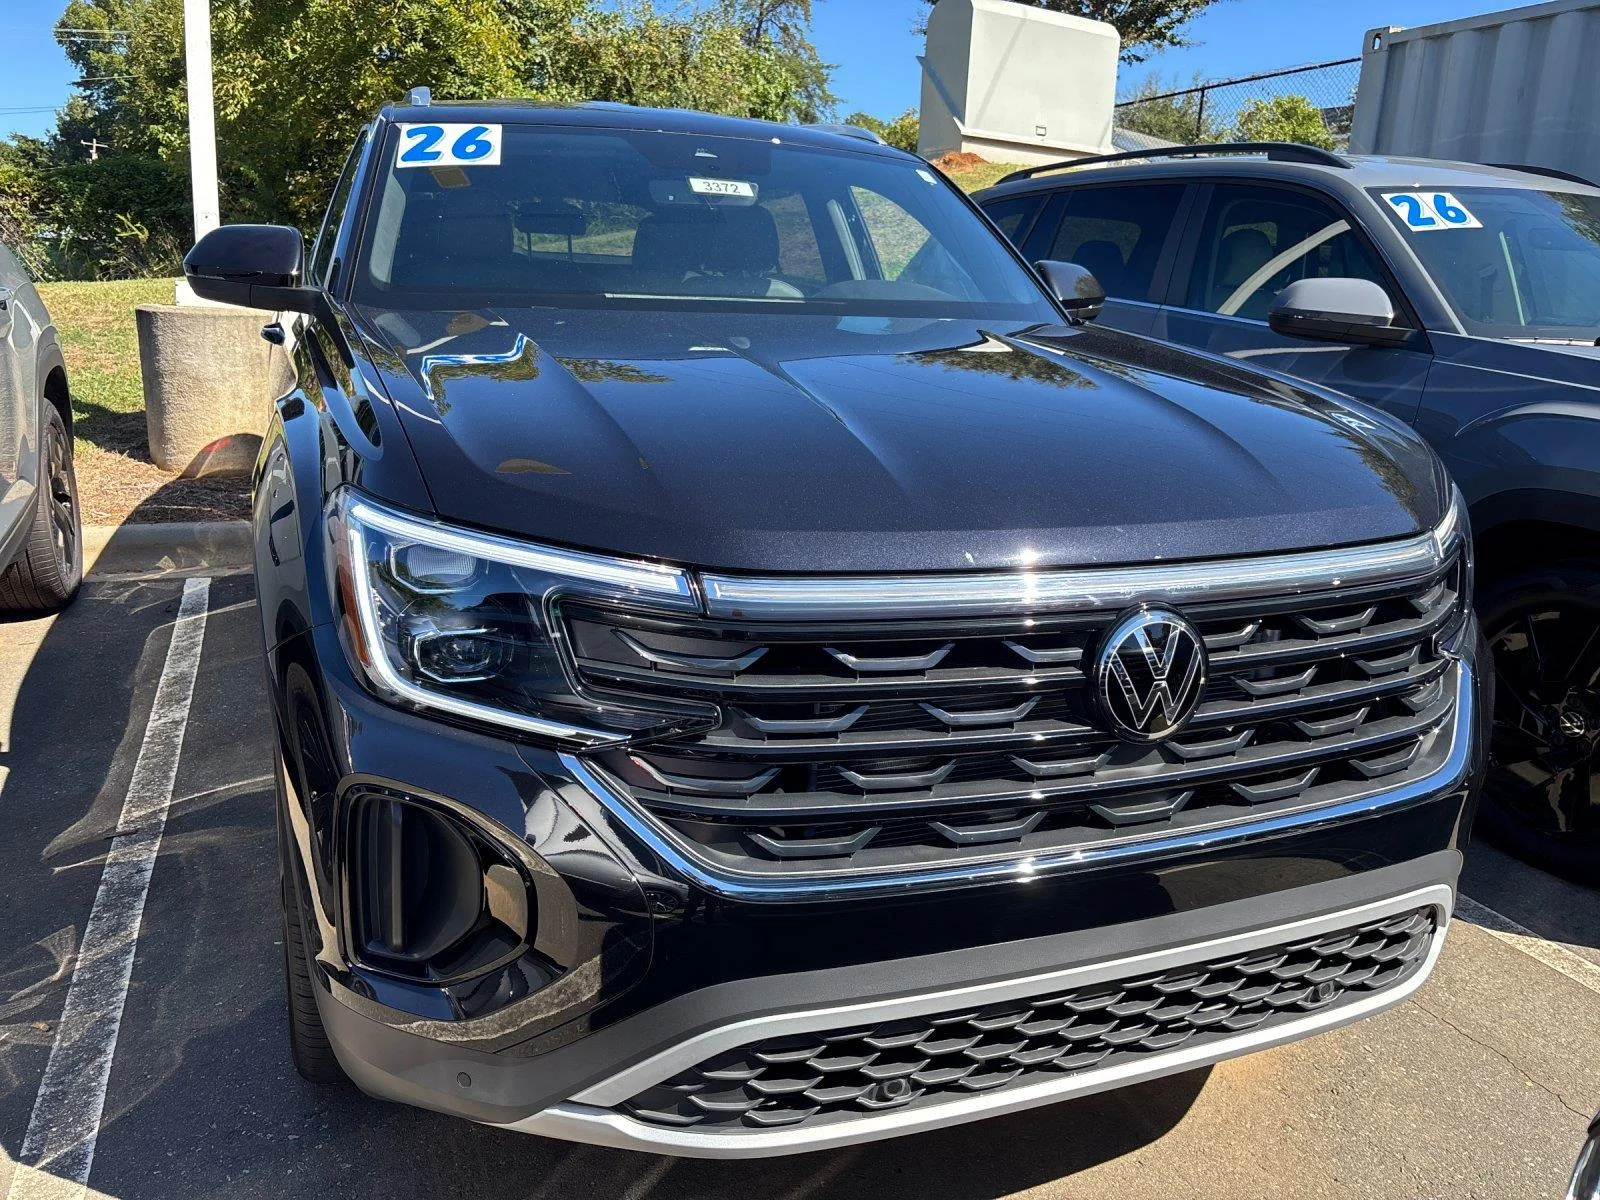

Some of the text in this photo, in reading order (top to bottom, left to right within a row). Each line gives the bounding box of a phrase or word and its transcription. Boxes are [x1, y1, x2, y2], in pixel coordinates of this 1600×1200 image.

[400, 125, 494, 163] 26
[702, 181, 741, 194] 3372
[1389, 194, 1468, 227] 26
